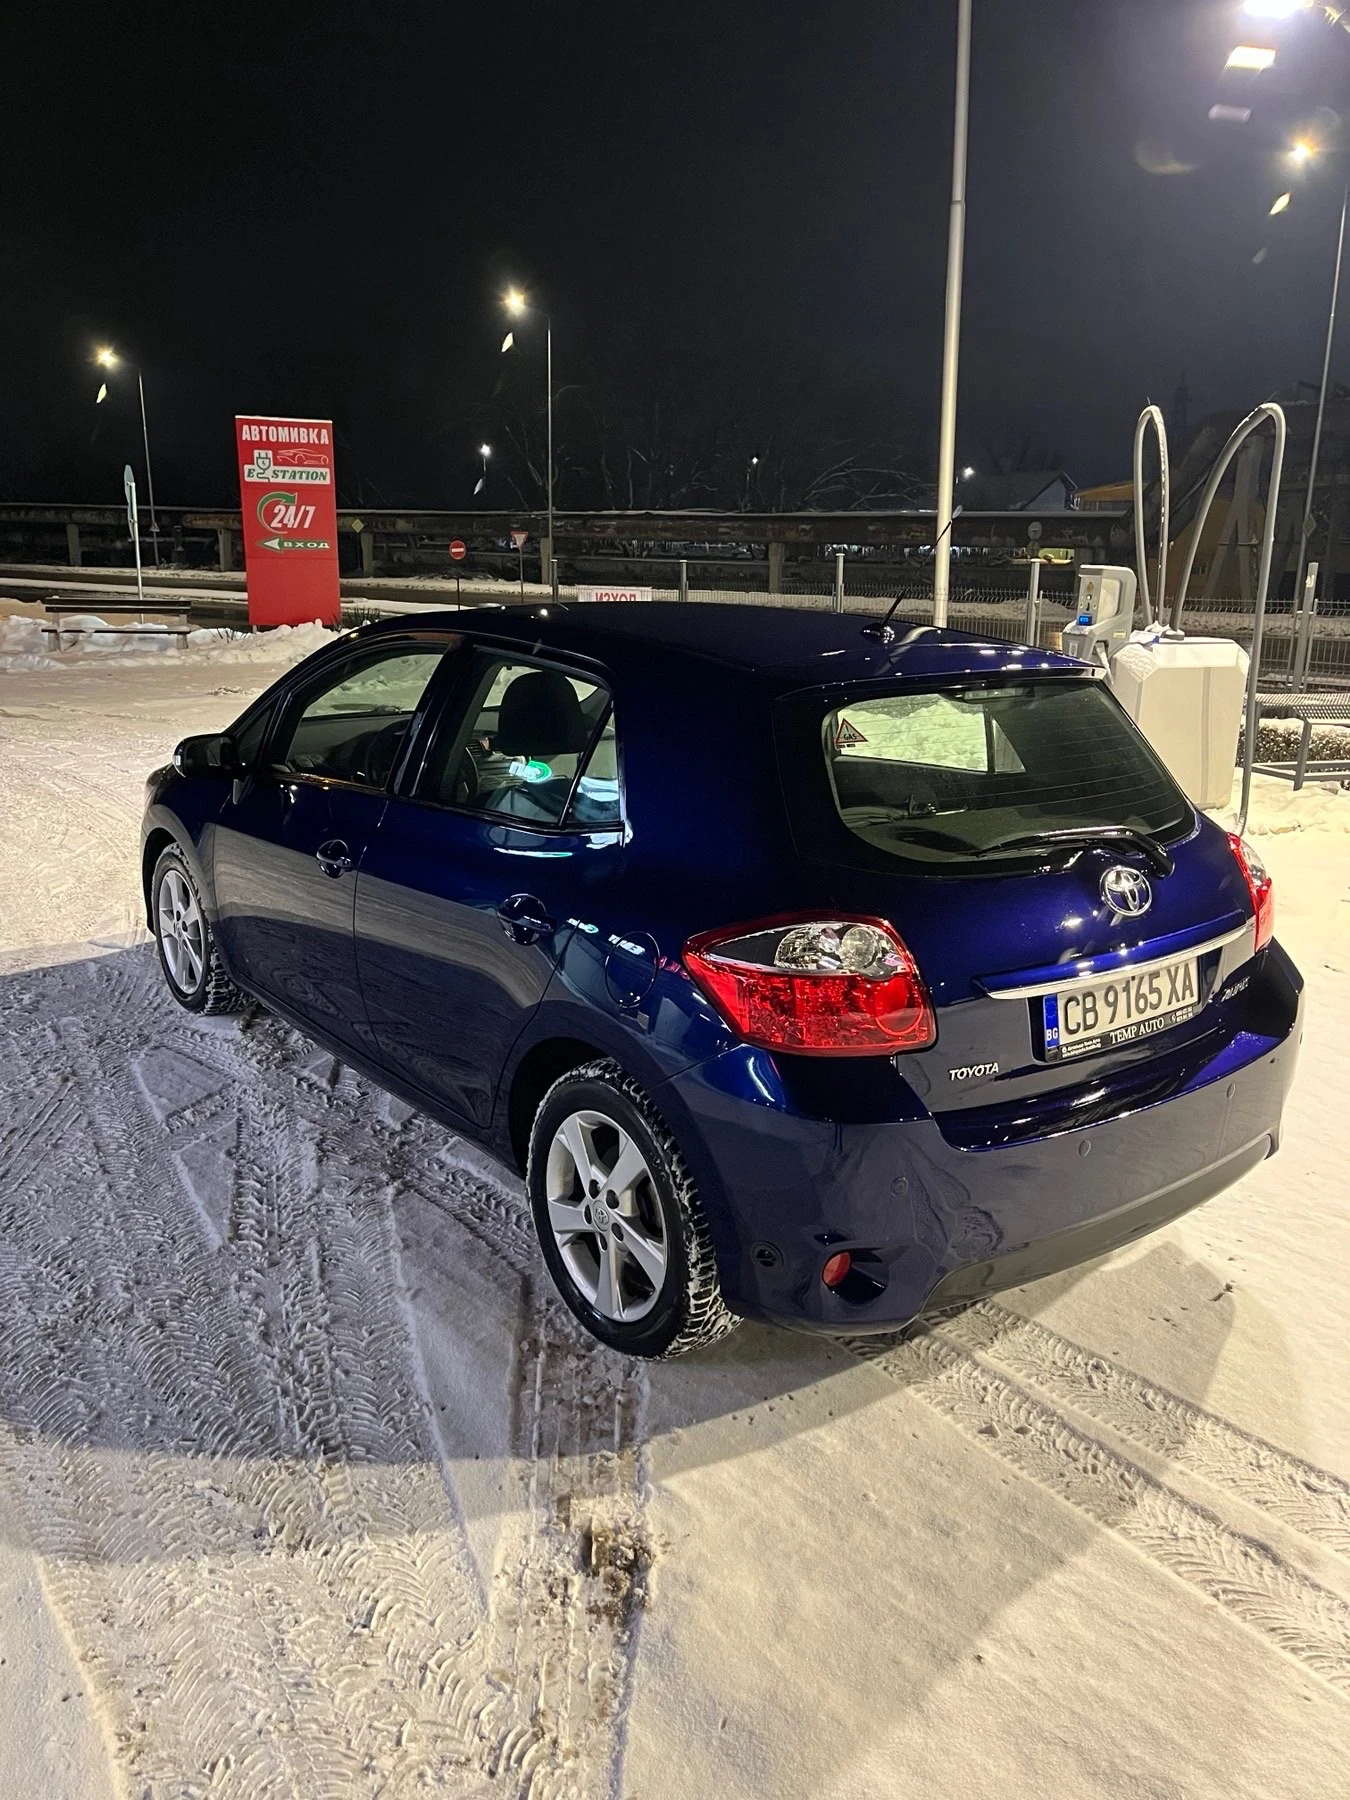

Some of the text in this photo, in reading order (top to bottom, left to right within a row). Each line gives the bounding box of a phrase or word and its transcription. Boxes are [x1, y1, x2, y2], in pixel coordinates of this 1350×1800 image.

[242, 424, 329, 445] АВТОМИВКА
[247, 468, 328, 481] E STATION
[270, 504, 316, 529] 24/7
[284, 541, 330, 549] ВХОД
[1064, 991, 1099, 1035] CB
[1104, 970, 1162, 1024] 9165
[1166, 963, 1194, 1006] XA
[1046, 1027, 1059, 1041] BG
[1110, 1017, 1165, 1044] TEMP AUTO
[949, 1062, 999, 1081] TOYOTA
